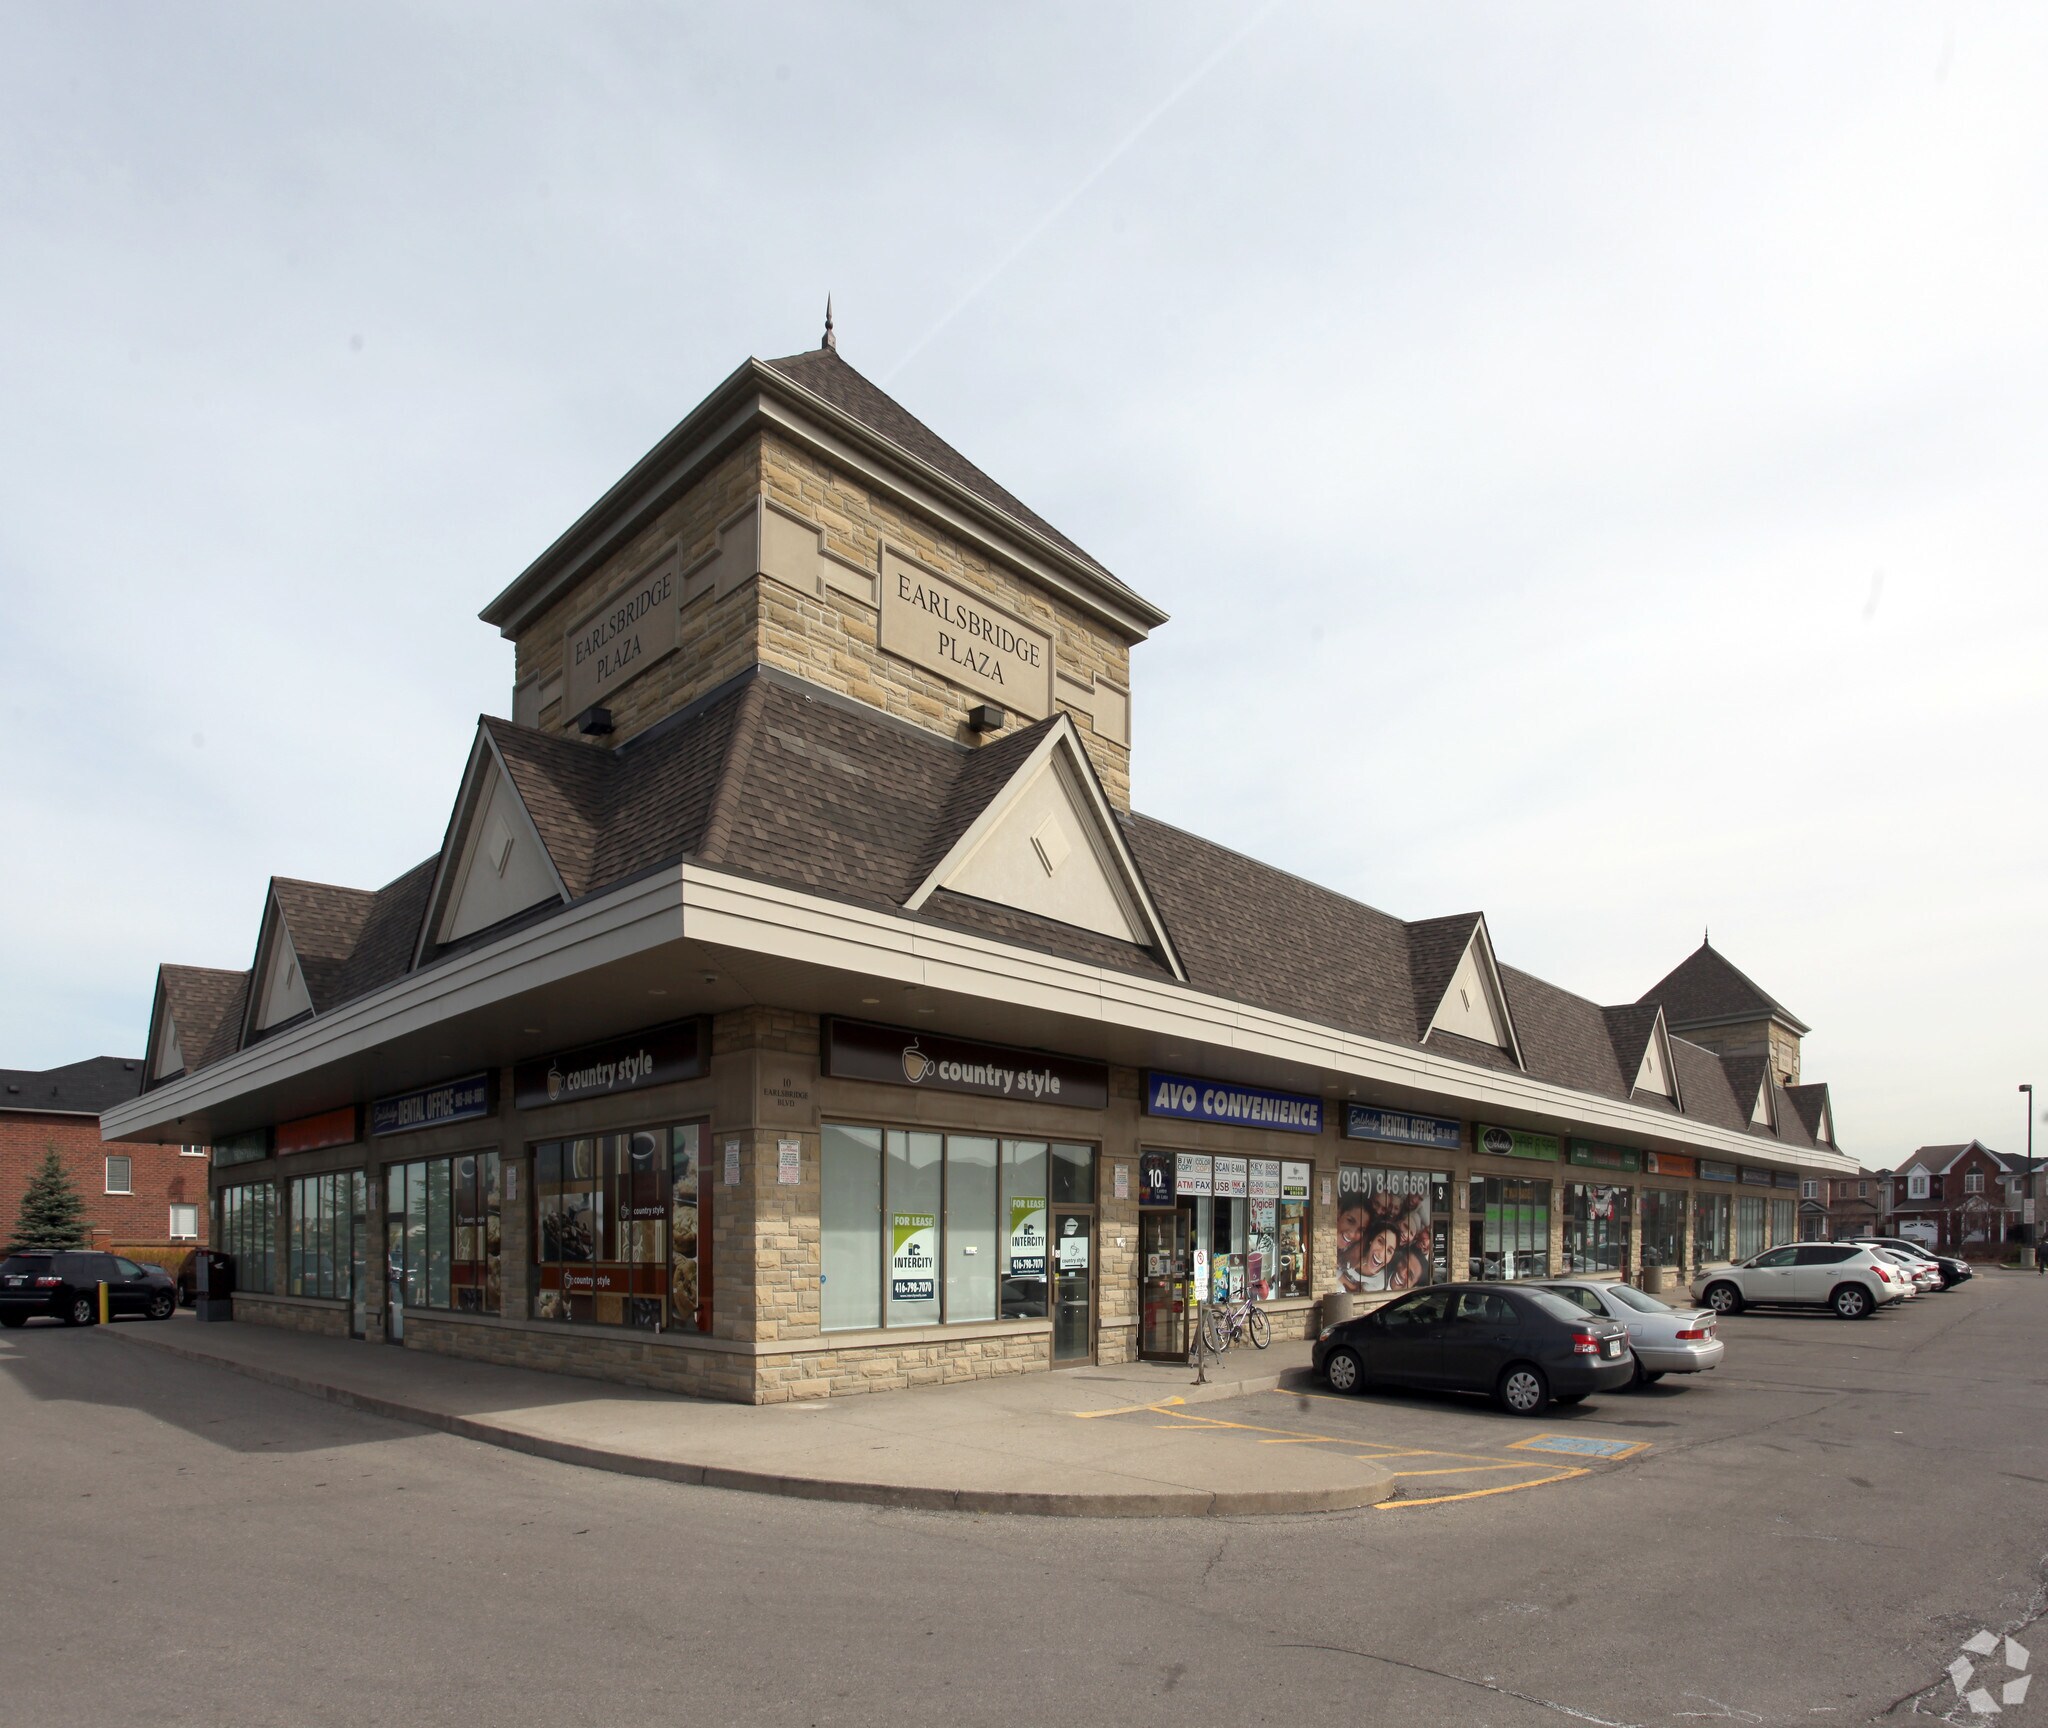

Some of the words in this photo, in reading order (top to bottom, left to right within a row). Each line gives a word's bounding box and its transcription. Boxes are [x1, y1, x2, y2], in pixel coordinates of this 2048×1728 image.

[576, 572, 672, 666] EARLSBRIDGE
[897, 572, 1041, 668] EARLSBRIDGE
[597, 633, 642, 684] PLAZA
[938, 631, 1004, 685] PLAZA
[567, 1062, 617, 1090] country
[618, 1049, 653, 1085] style
[782, 1077, 792, 1088] 10
[939, 1060, 1014, 1094] country
[1017, 1069, 1061, 1098] style
[763, 1088, 808, 1100] EARLSBRIDGE
[398, 1096, 425, 1126] DENTAL
[426, 1088, 454, 1120] OFFICE
[777, 1099, 795, 1107] BLVD
[1154, 1082, 1197, 1113] AVO
[1202, 1089, 1319, 1127] CONVENIENCE
[1380, 1113, 1410, 1139] DENTAL
[1410, 1118, 1436, 1142] OFFICE
[1215, 1162, 1230, 1172] SCAN
[1231, 1163, 1246, 1173] E-MAIL
[1148, 1169, 1162, 1188] 10
[1177, 1180, 1193, 1188] ATM
[1195, 1180, 1211, 1189] FAX
[1337, 1169, 1372, 1199] (905)
[1376, 1173, 1400, 1195] 846
[1402, 1175, 1430, 1196] 6661
[1214, 1181, 1230, 1191] USB
[1438, 1186, 1444, 1200] 9
[633, 1206, 652, 1216] country
[652, 1205, 665, 1215] style
[1012, 1199, 1026, 1208] FOR
[1027, 1199, 1045, 1209] LEASE
[1251, 1198, 1275, 1211] Digicel
[894, 1216, 910, 1226] FOR
[912, 1217, 934, 1227] LEASE
[1012, 1236, 1045, 1247] INTERCITY
[894, 1256, 933, 1269] INTERCITY
